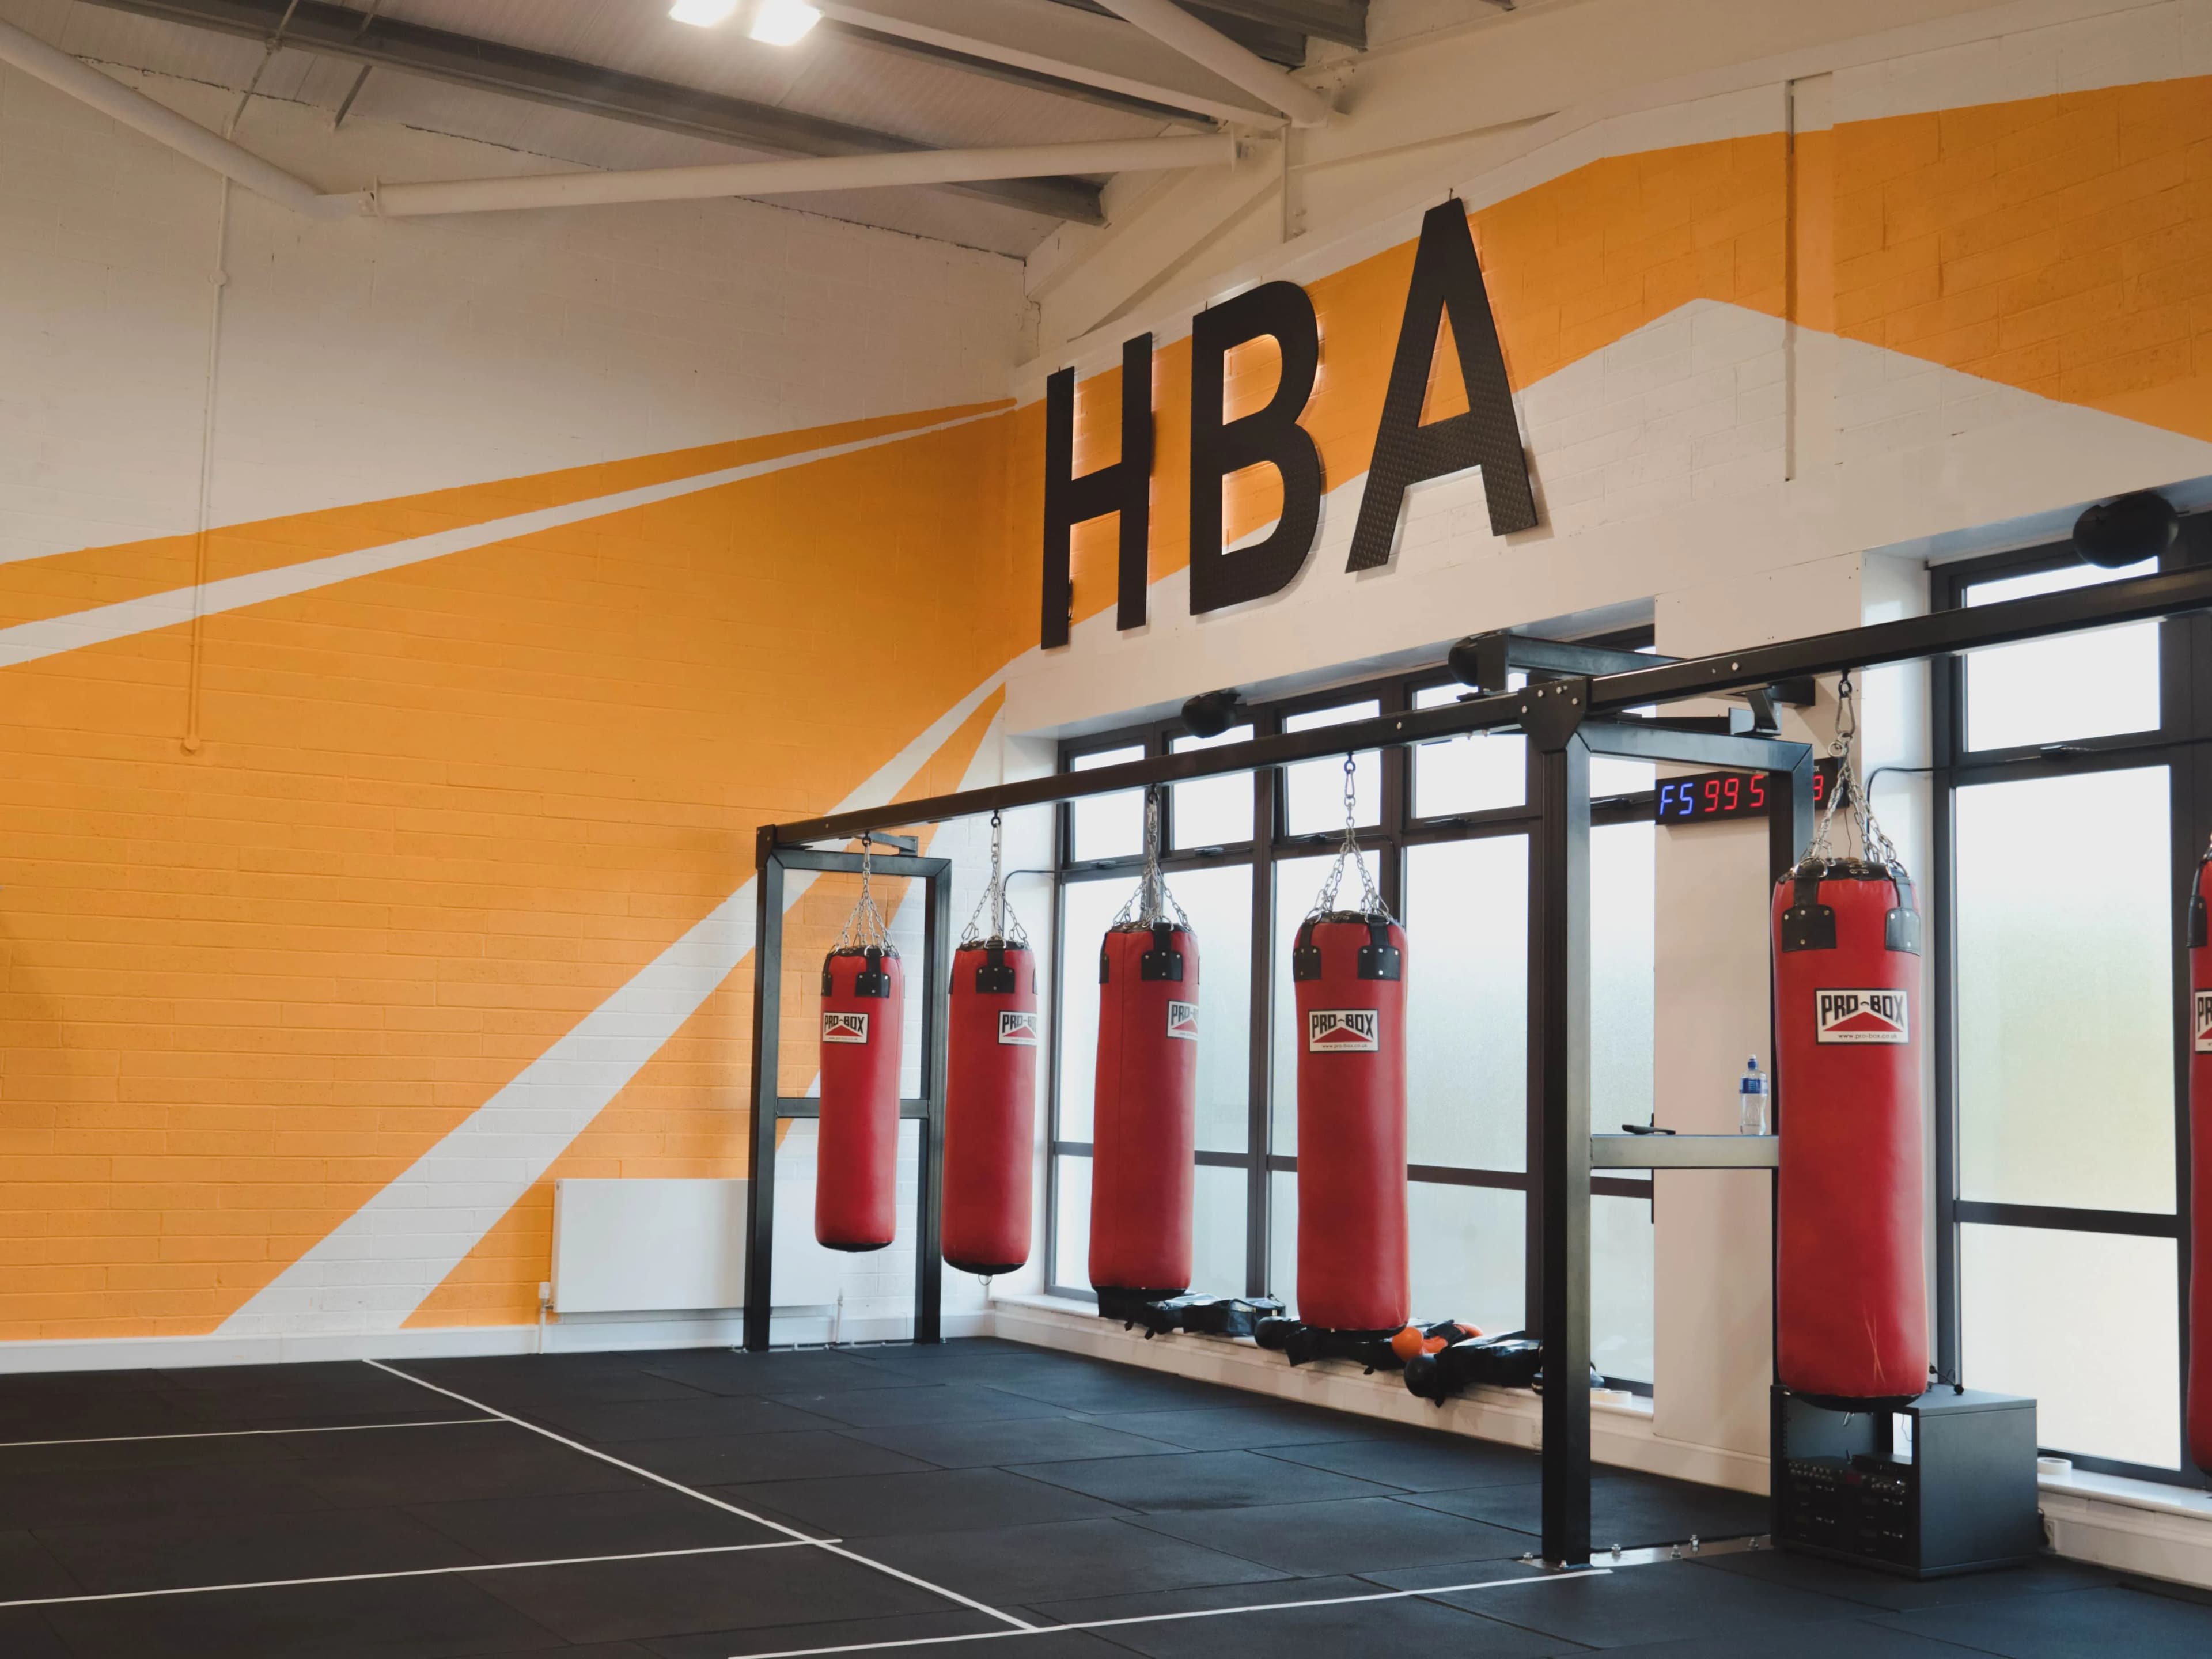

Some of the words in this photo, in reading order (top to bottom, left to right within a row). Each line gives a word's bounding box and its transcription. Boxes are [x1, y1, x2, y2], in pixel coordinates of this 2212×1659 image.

[1041, 196, 1539, 649] HBA
[824, 1015, 865, 1034] PRO-BOX
[1002, 1014, 1037, 1033] PRO-BO
[1821, 995, 1904, 1027] PRO-BOX
[2197, 997, 2212, 1033] PR
[1312, 1014, 1373, 1039] PRO-BOX
